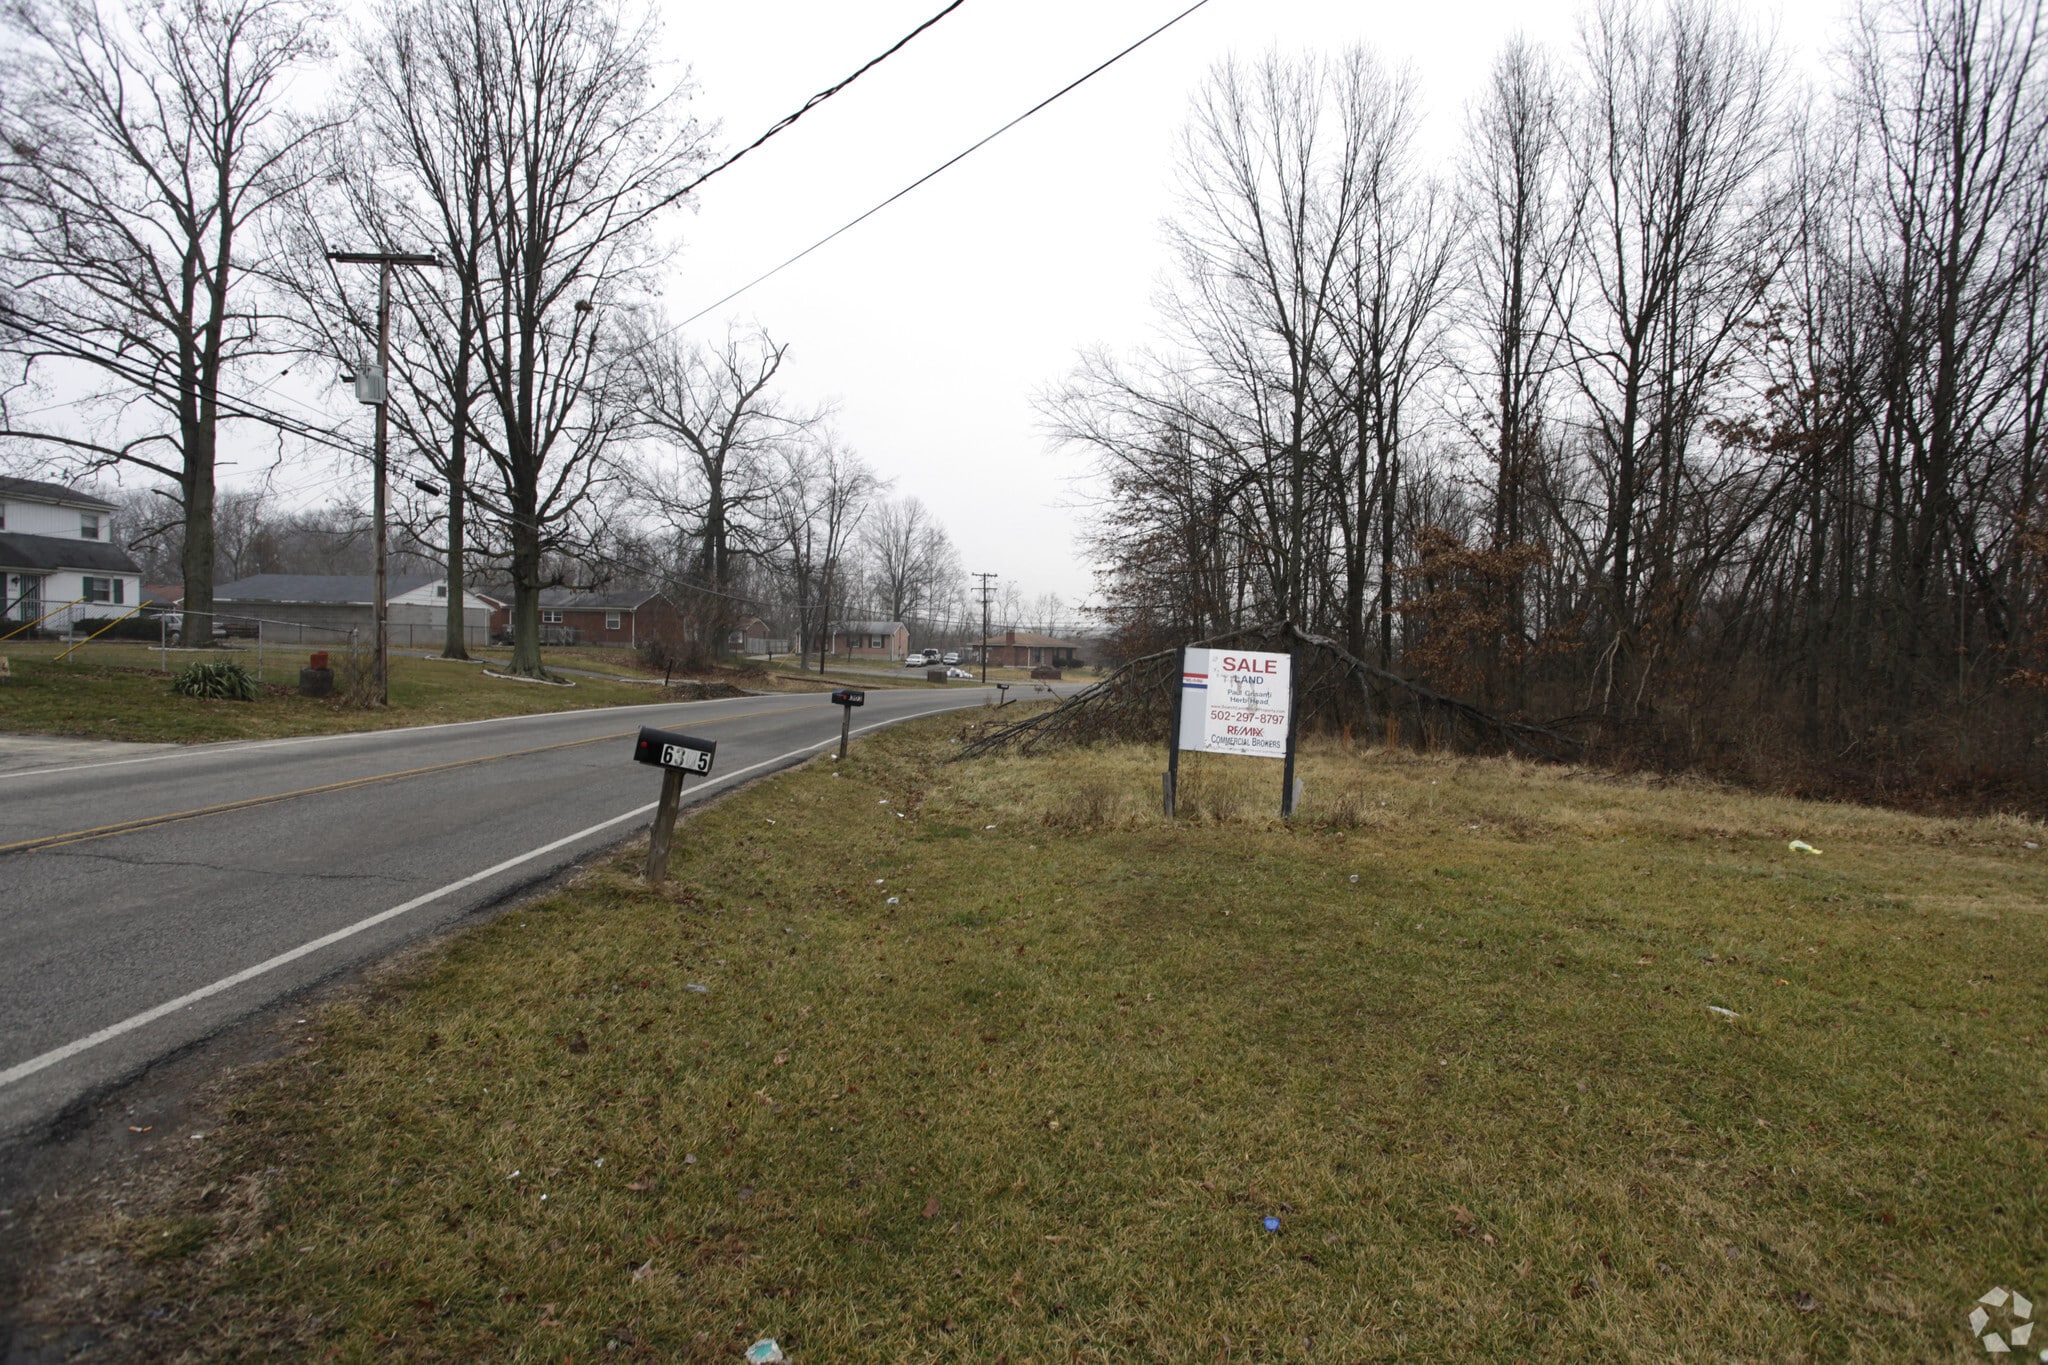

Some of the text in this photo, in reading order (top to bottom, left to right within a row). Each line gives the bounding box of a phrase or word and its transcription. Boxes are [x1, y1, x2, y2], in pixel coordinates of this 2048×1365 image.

[1222, 656, 1277, 674] SALE
[1234, 674, 1264, 685] LAND
[1250, 697, 1269, 705] Head
[1210, 710, 1285, 724] 502-297-8797
[1227, 725, 1264, 737] RE/MAX
